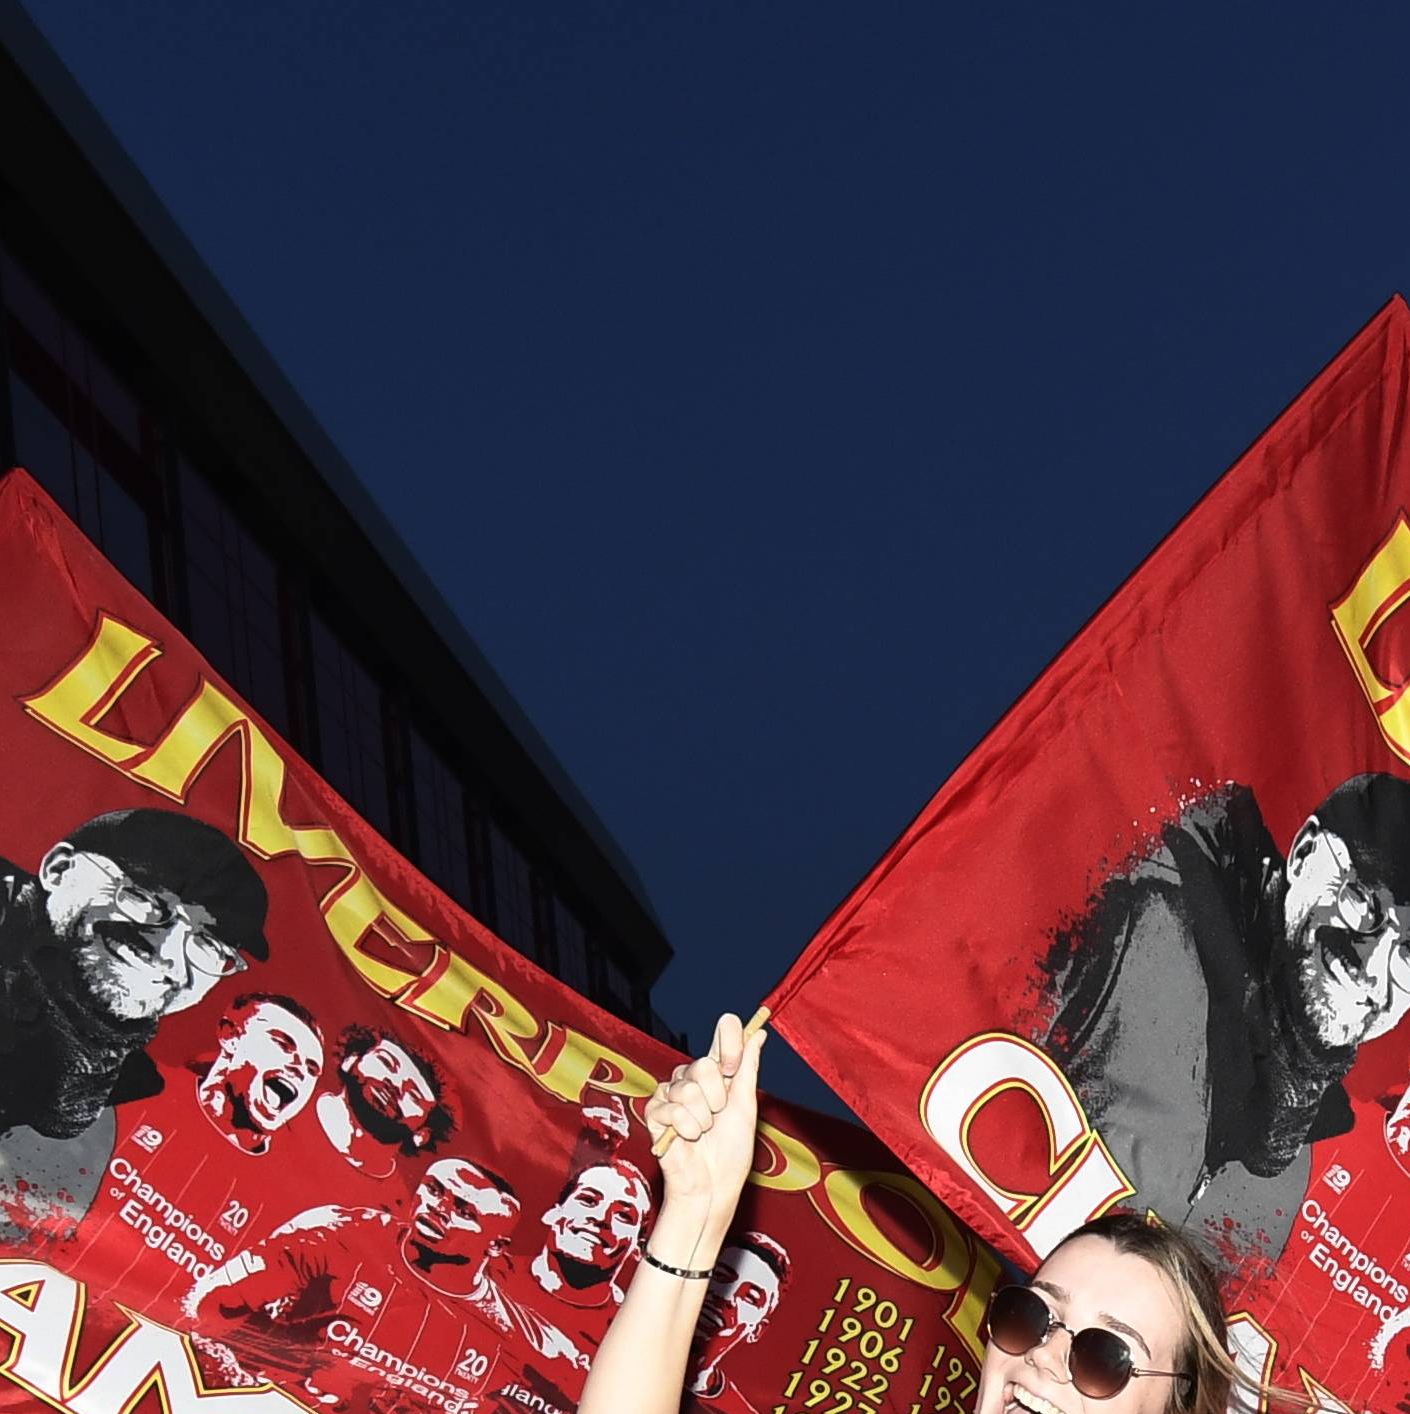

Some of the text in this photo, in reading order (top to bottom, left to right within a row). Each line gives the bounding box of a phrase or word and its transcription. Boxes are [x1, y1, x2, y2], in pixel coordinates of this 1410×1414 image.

[109, 1158, 225, 1261] Champions
[119, 1199, 215, 1281] England
[222, 1200, 249, 1228] 20
[1302, 1199, 1409, 1303] Champions
[1309, 1243, 1400, 1323] England
[818, 1309, 903, 1372] 1906
[834, 1278, 914, 1341] 1901
[327, 1320, 471, 1399] Champions
[457, 1348, 488, 1377] 20
[801, 1339, 888, 1404] 1922
[932, 1346, 977, 1399] 197
